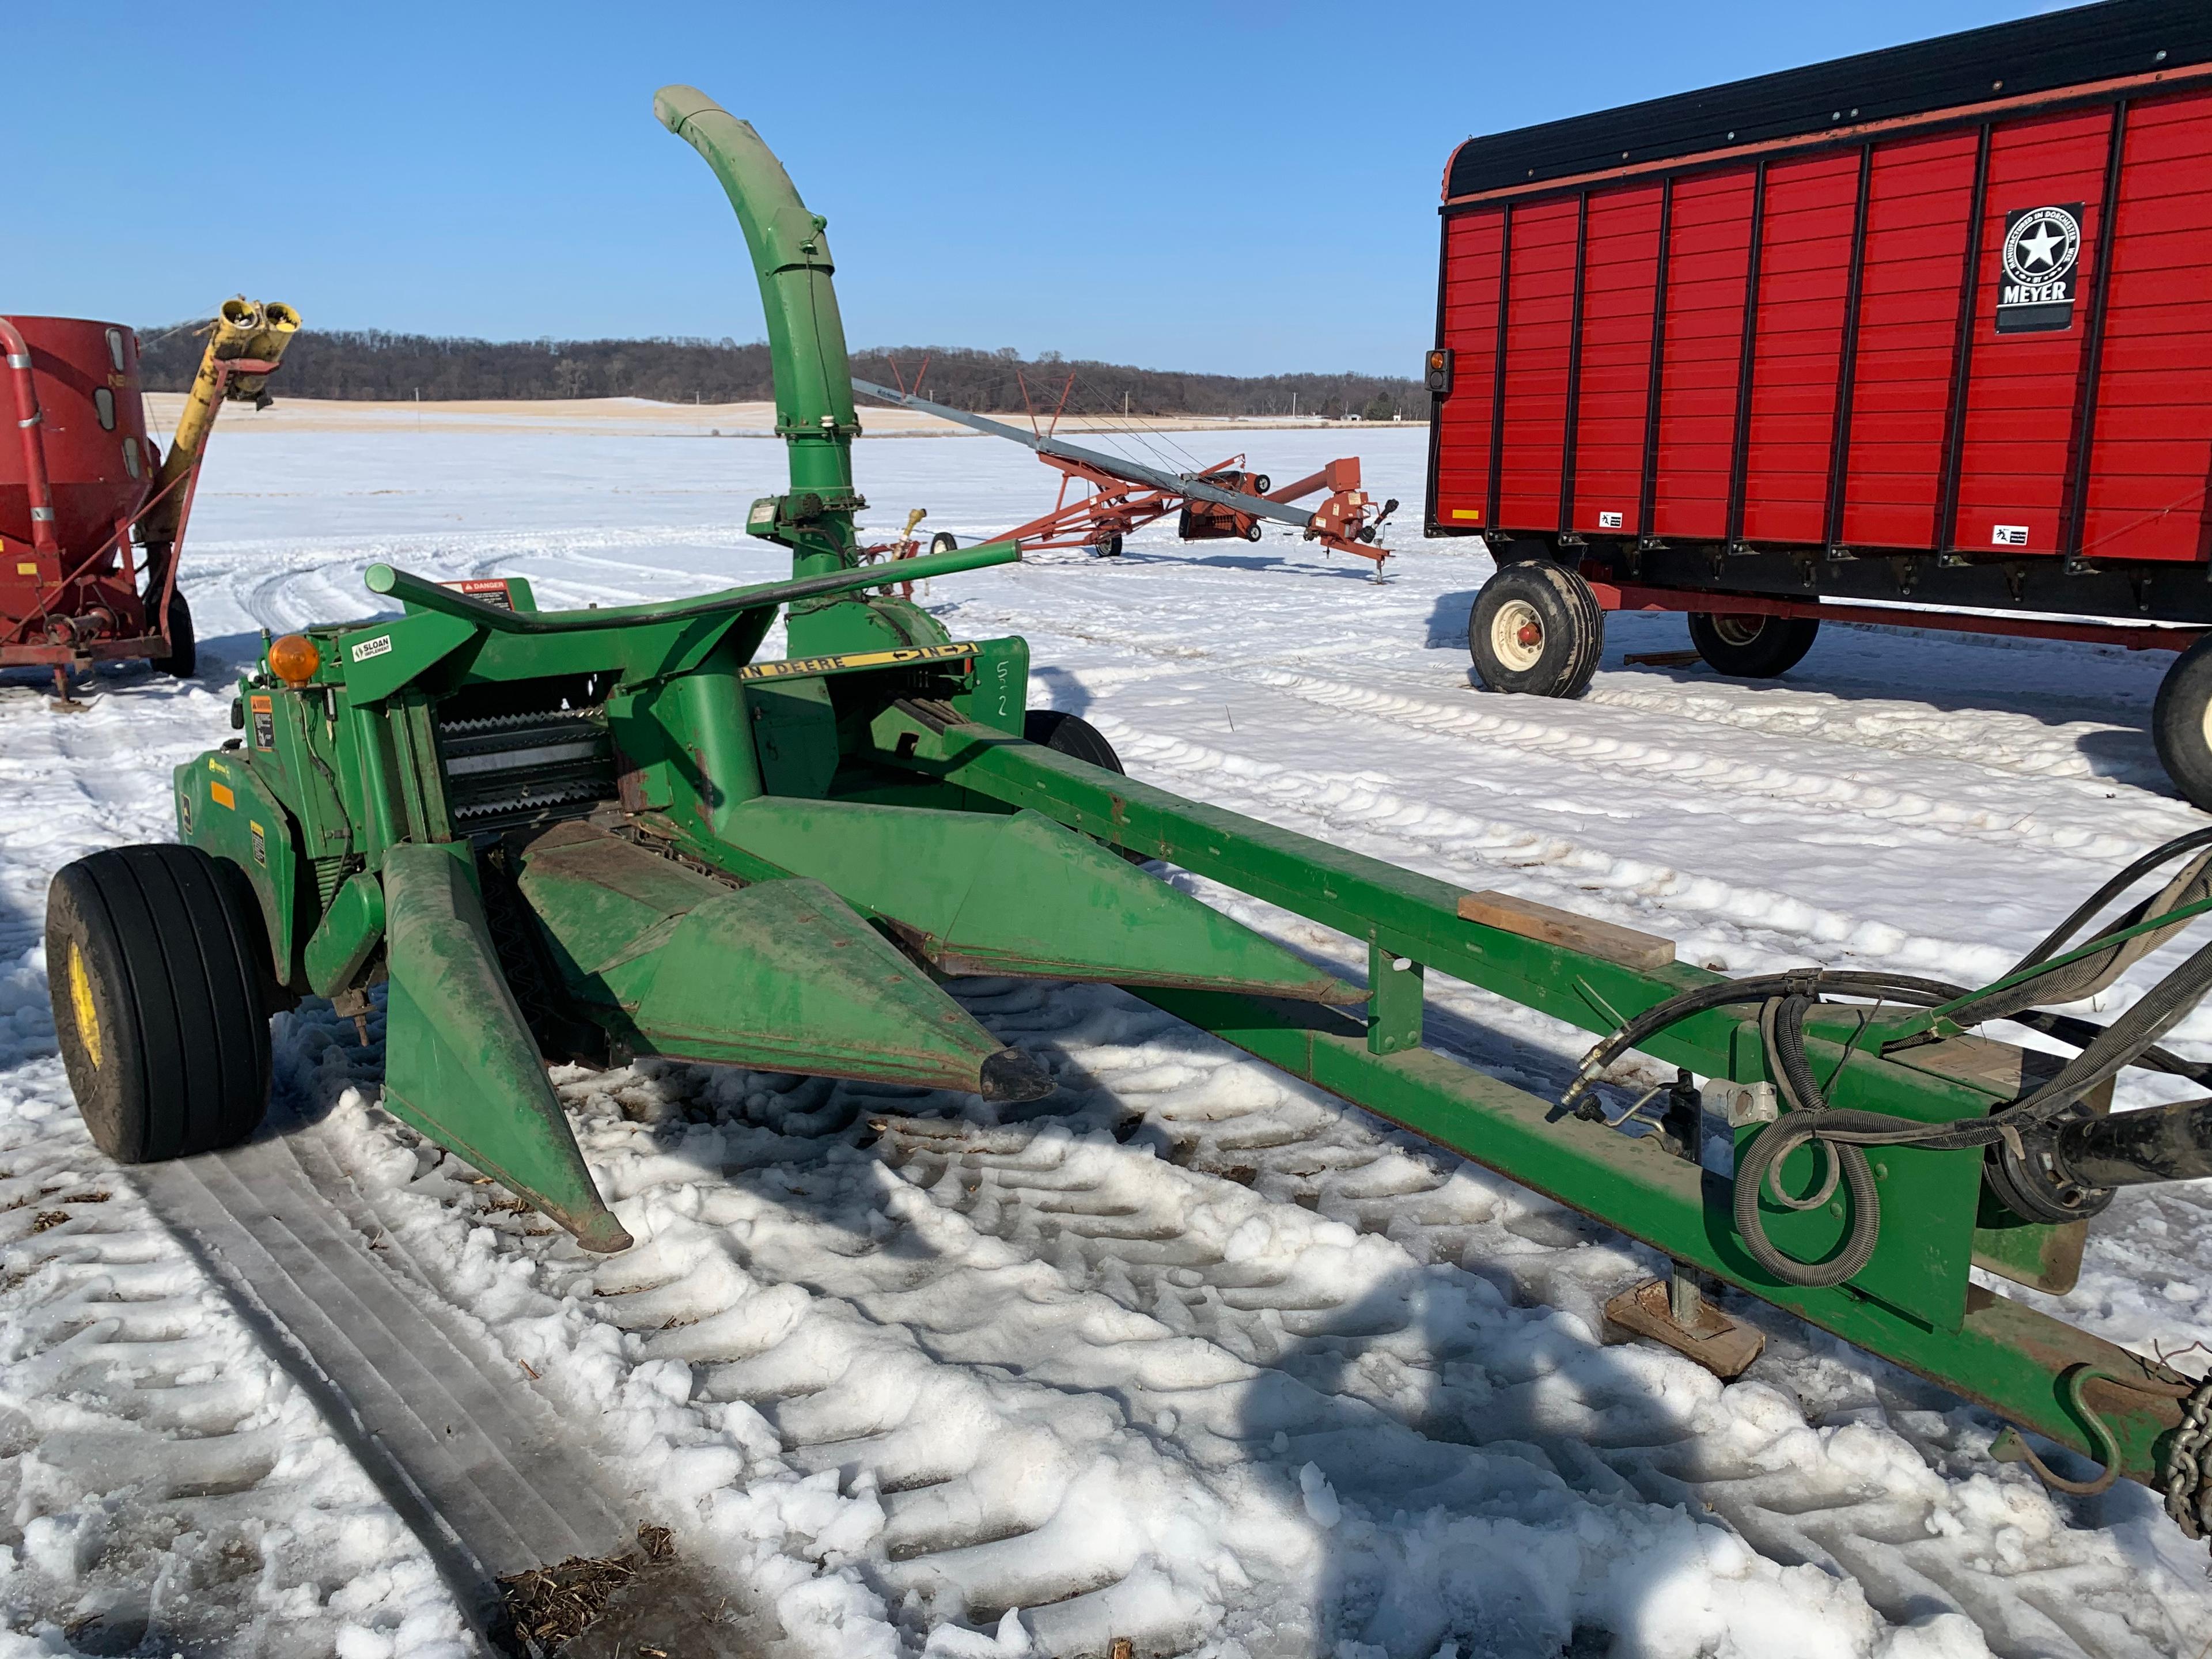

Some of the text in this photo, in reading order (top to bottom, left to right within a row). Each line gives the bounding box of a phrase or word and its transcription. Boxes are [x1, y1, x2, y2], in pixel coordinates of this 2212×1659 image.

[2007, 216, 2033, 269] MANUFACTURED
[2035, 211, 2044, 219] IN
[2004, 281, 2066, 304] MEYER
[474, 581, 504, 590] DANGER
[363, 638, 388, 652] SLOAN
[365, 646, 389, 656] IMPLEMENT
[775, 657, 846, 675] DEERE
